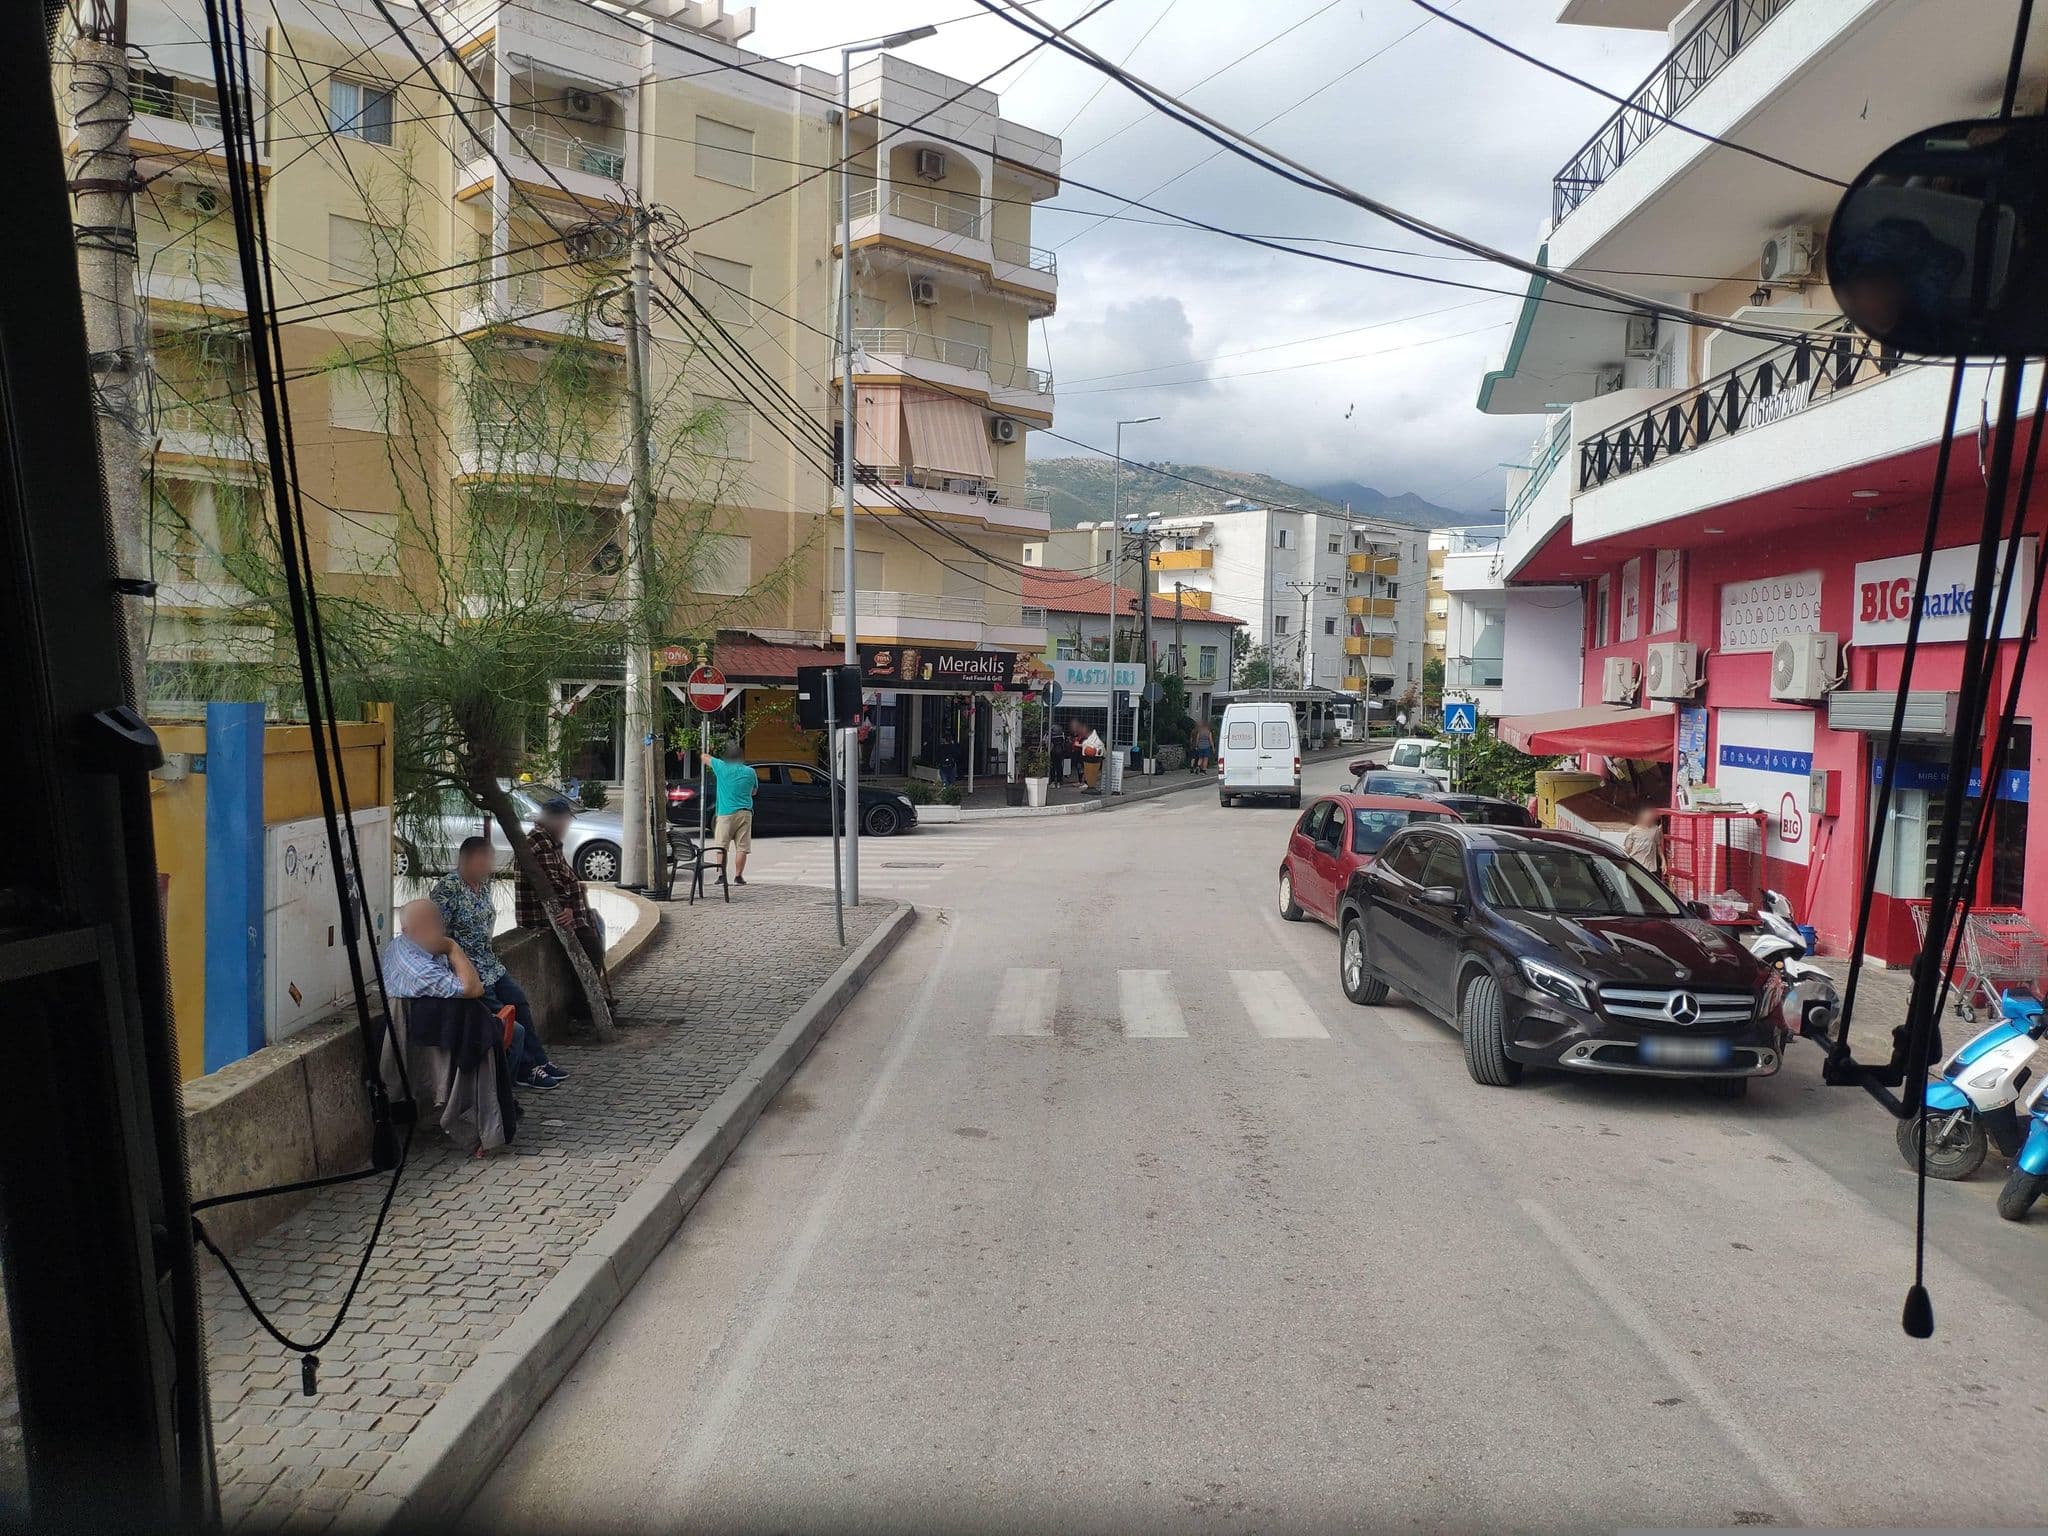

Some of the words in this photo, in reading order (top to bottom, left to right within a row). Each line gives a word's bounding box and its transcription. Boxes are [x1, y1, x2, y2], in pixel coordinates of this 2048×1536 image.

[1860, 577, 1910, 622] BIG
[938, 655, 1004, 673] Meraklis
[1067, 668, 1137, 686] PASTIERI
[1783, 818, 1799, 834] BIG
